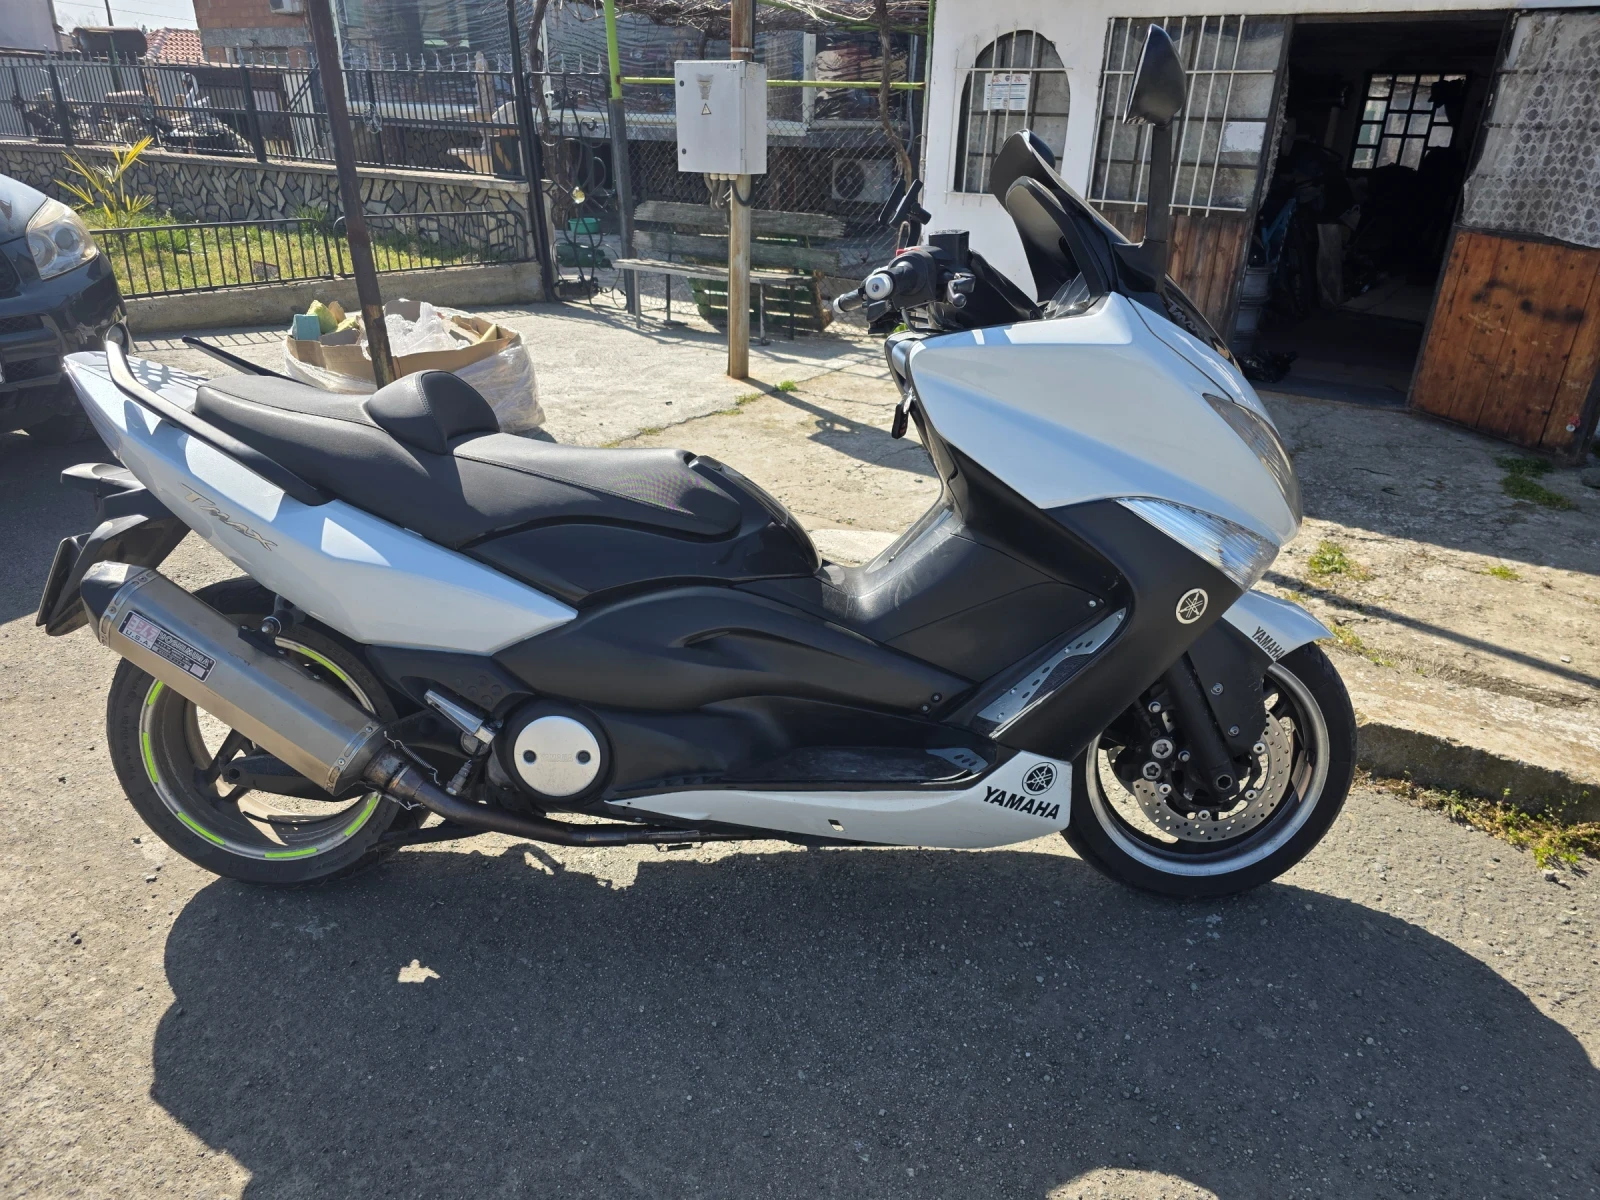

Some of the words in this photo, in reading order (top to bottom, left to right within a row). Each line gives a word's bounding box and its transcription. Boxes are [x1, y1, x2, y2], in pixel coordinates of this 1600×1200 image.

[125, 629, 151, 648] U.S.A.
[157, 631, 210, 668] YOSHIMURA
[1251, 625, 1286, 661] YAMAHA
[983, 785, 1060, 820] YAMAHA
